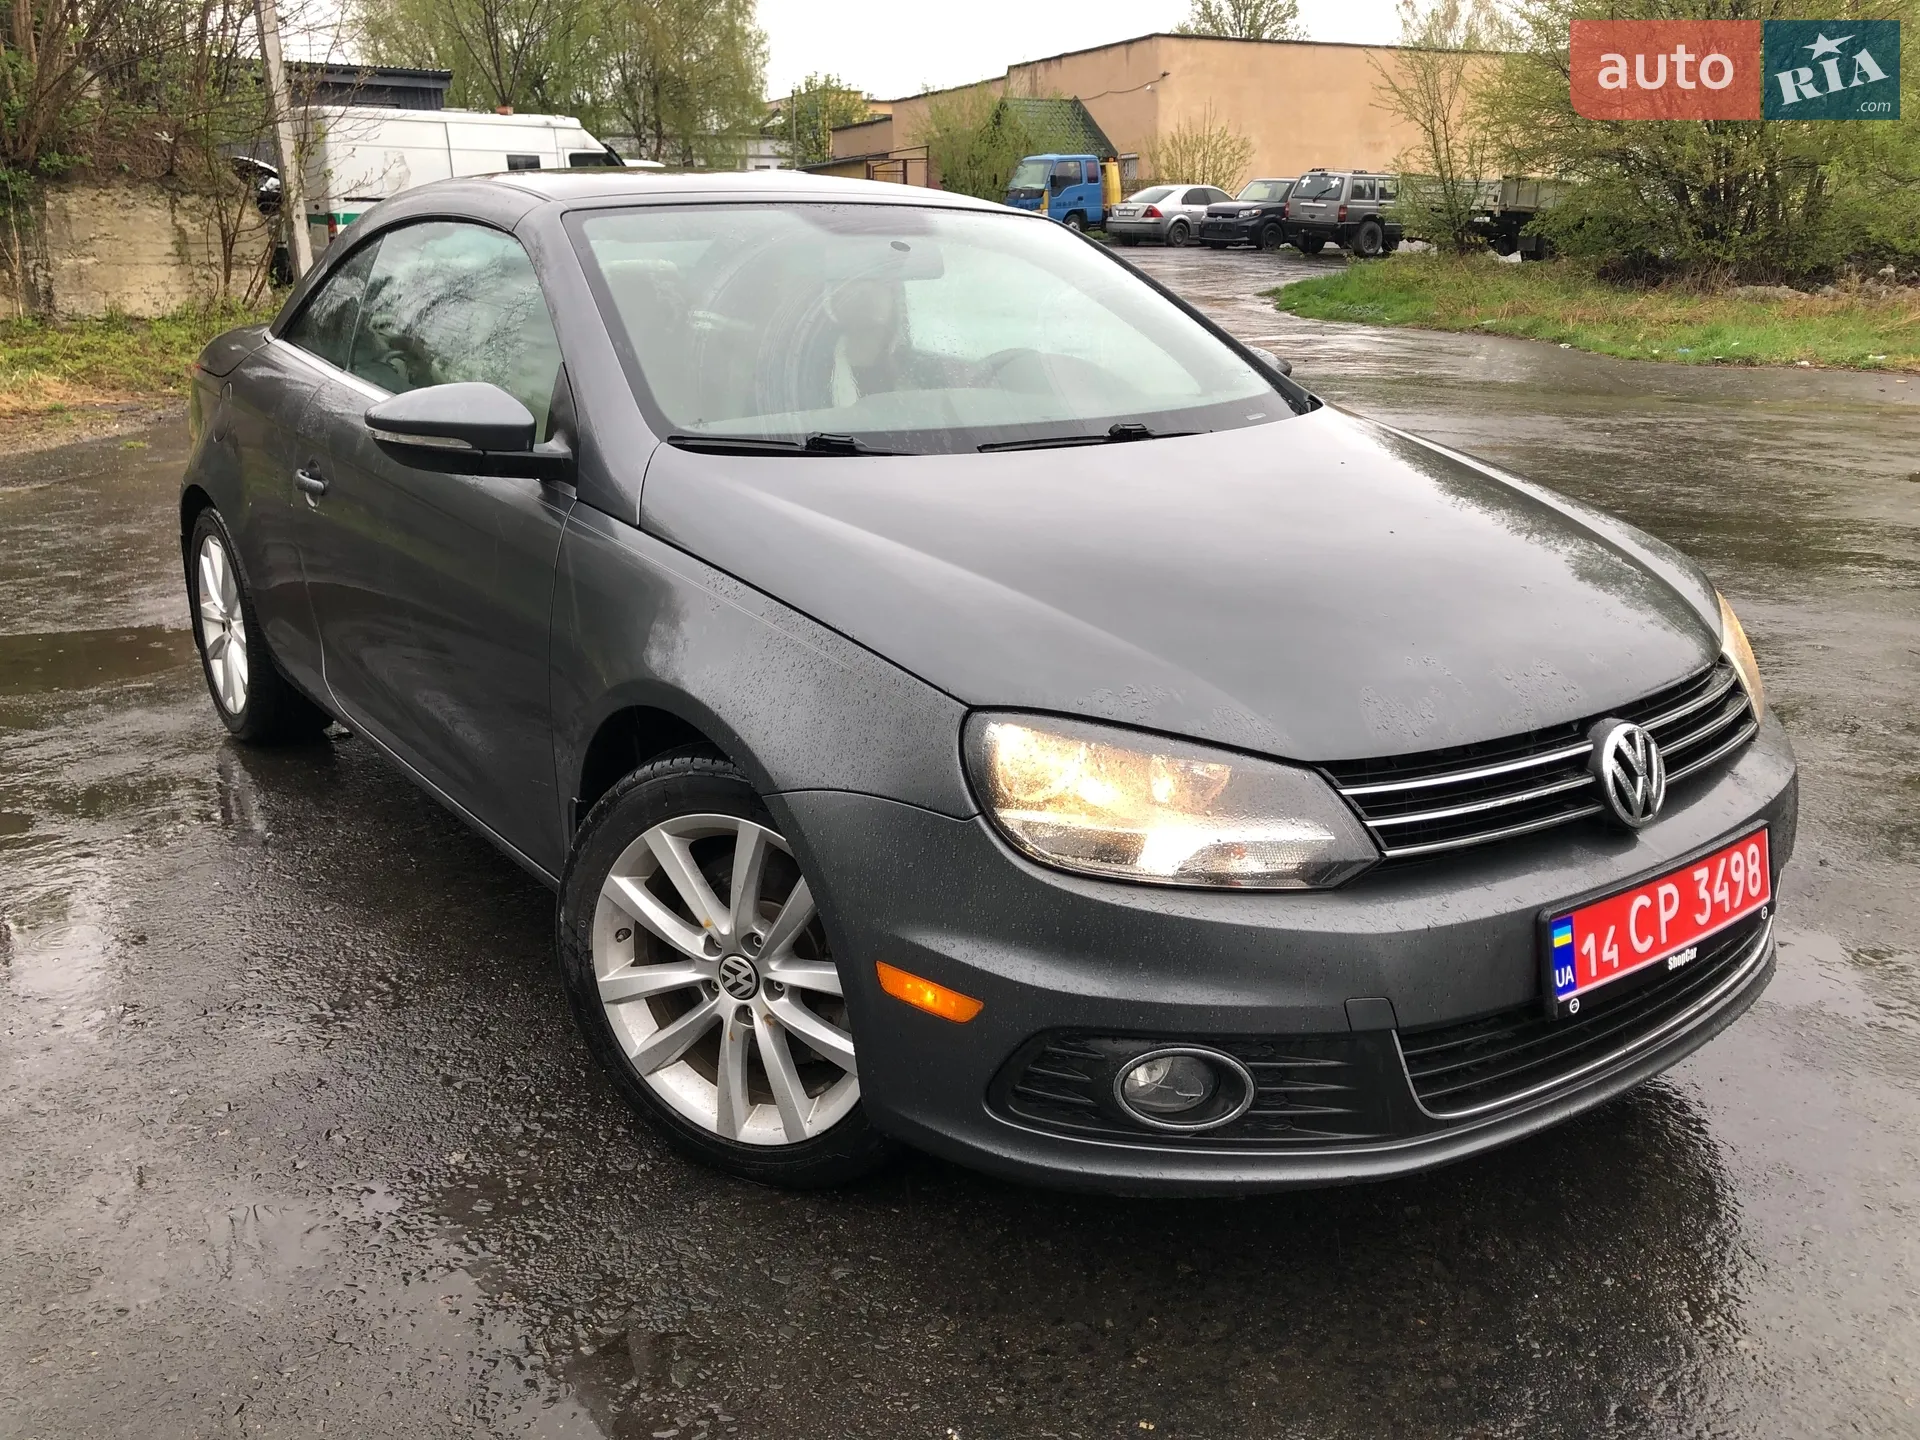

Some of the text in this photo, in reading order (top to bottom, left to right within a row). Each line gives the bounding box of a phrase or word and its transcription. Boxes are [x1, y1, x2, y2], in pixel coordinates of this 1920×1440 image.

[1581, 843, 1762, 977] 14 CP 3498
[1668, 947, 1698, 971] ShopCar
[1555, 965, 1575, 988] UA
